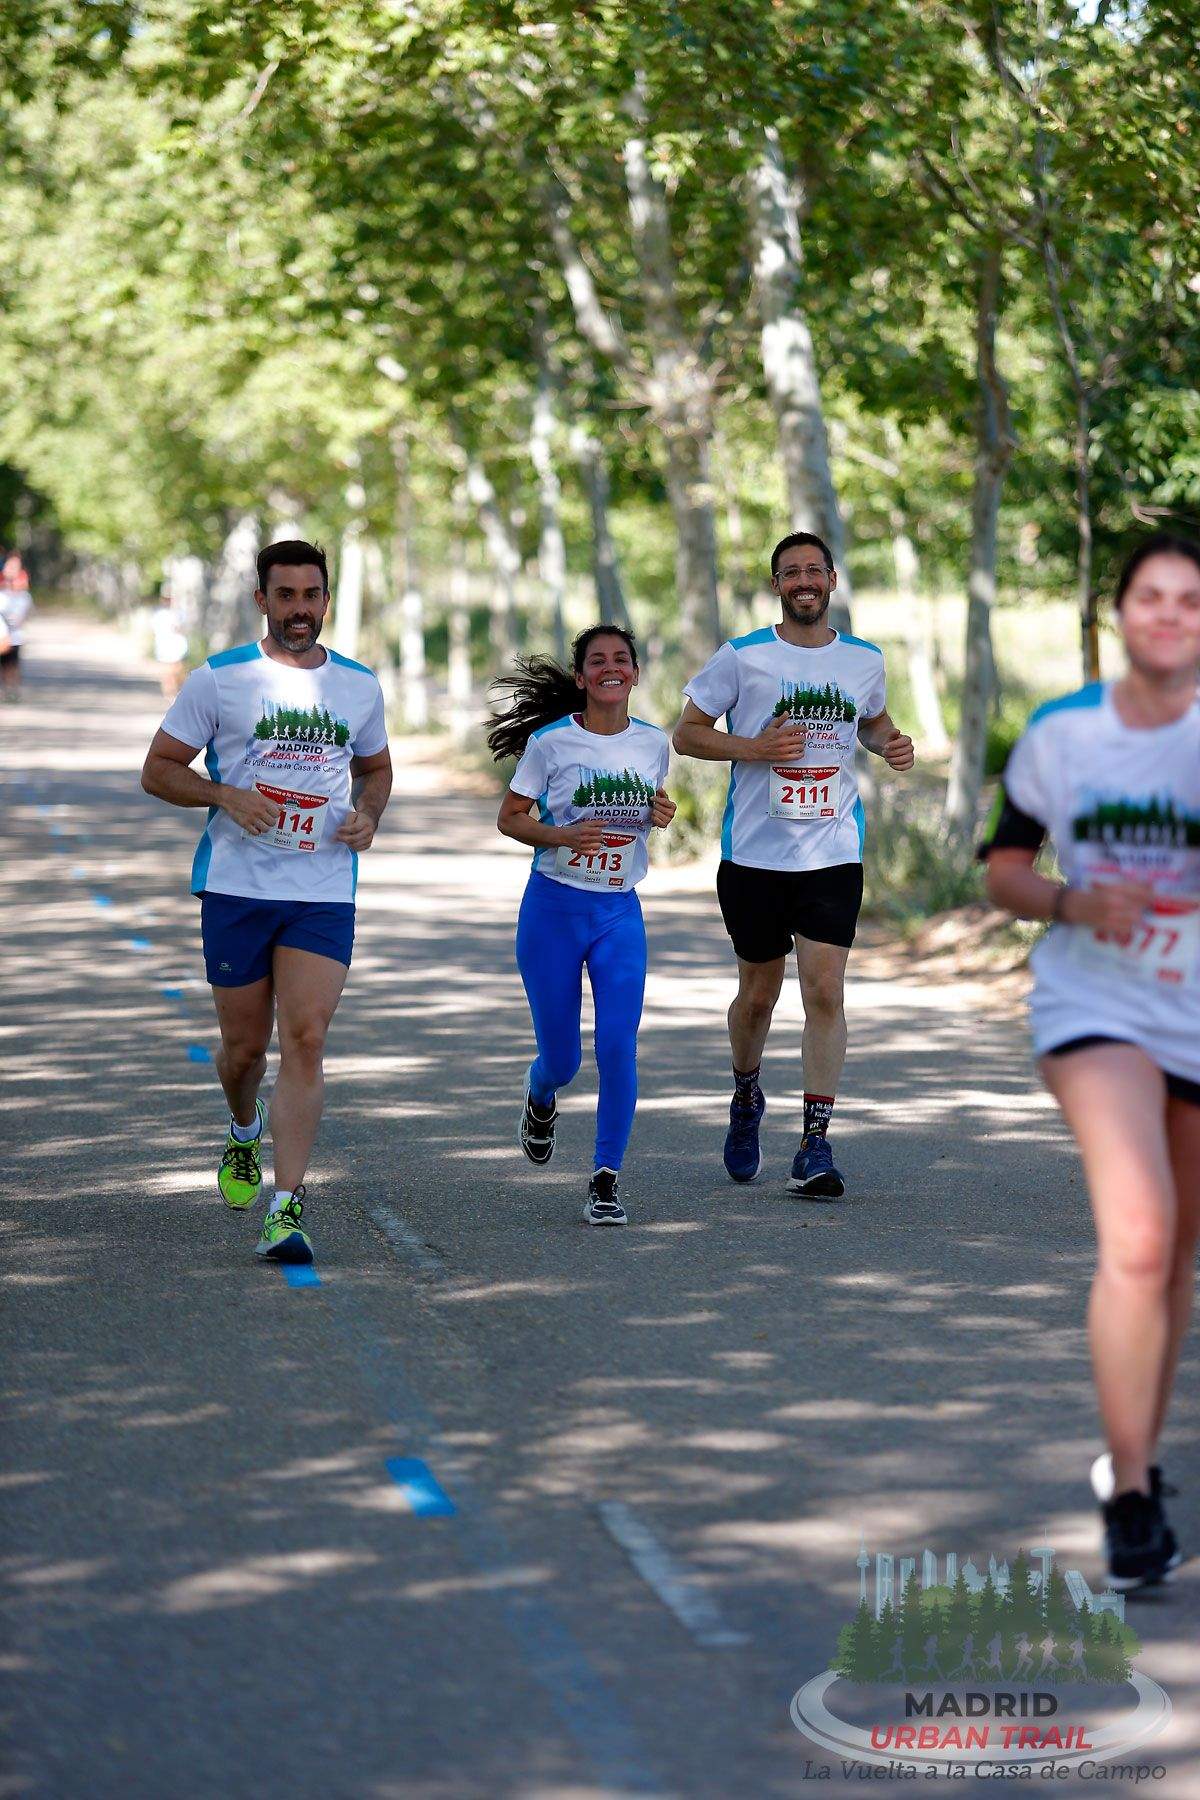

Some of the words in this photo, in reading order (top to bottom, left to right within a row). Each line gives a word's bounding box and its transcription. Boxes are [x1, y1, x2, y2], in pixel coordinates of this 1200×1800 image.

[275, 743, 323, 755] MADRID
[252, 759, 276, 769] Vuelta
[293, 763, 311, 772] Casa
[313, 764, 321, 772] de
[781, 786, 829, 804] 2111
[594, 809, 640, 818] MADRID
